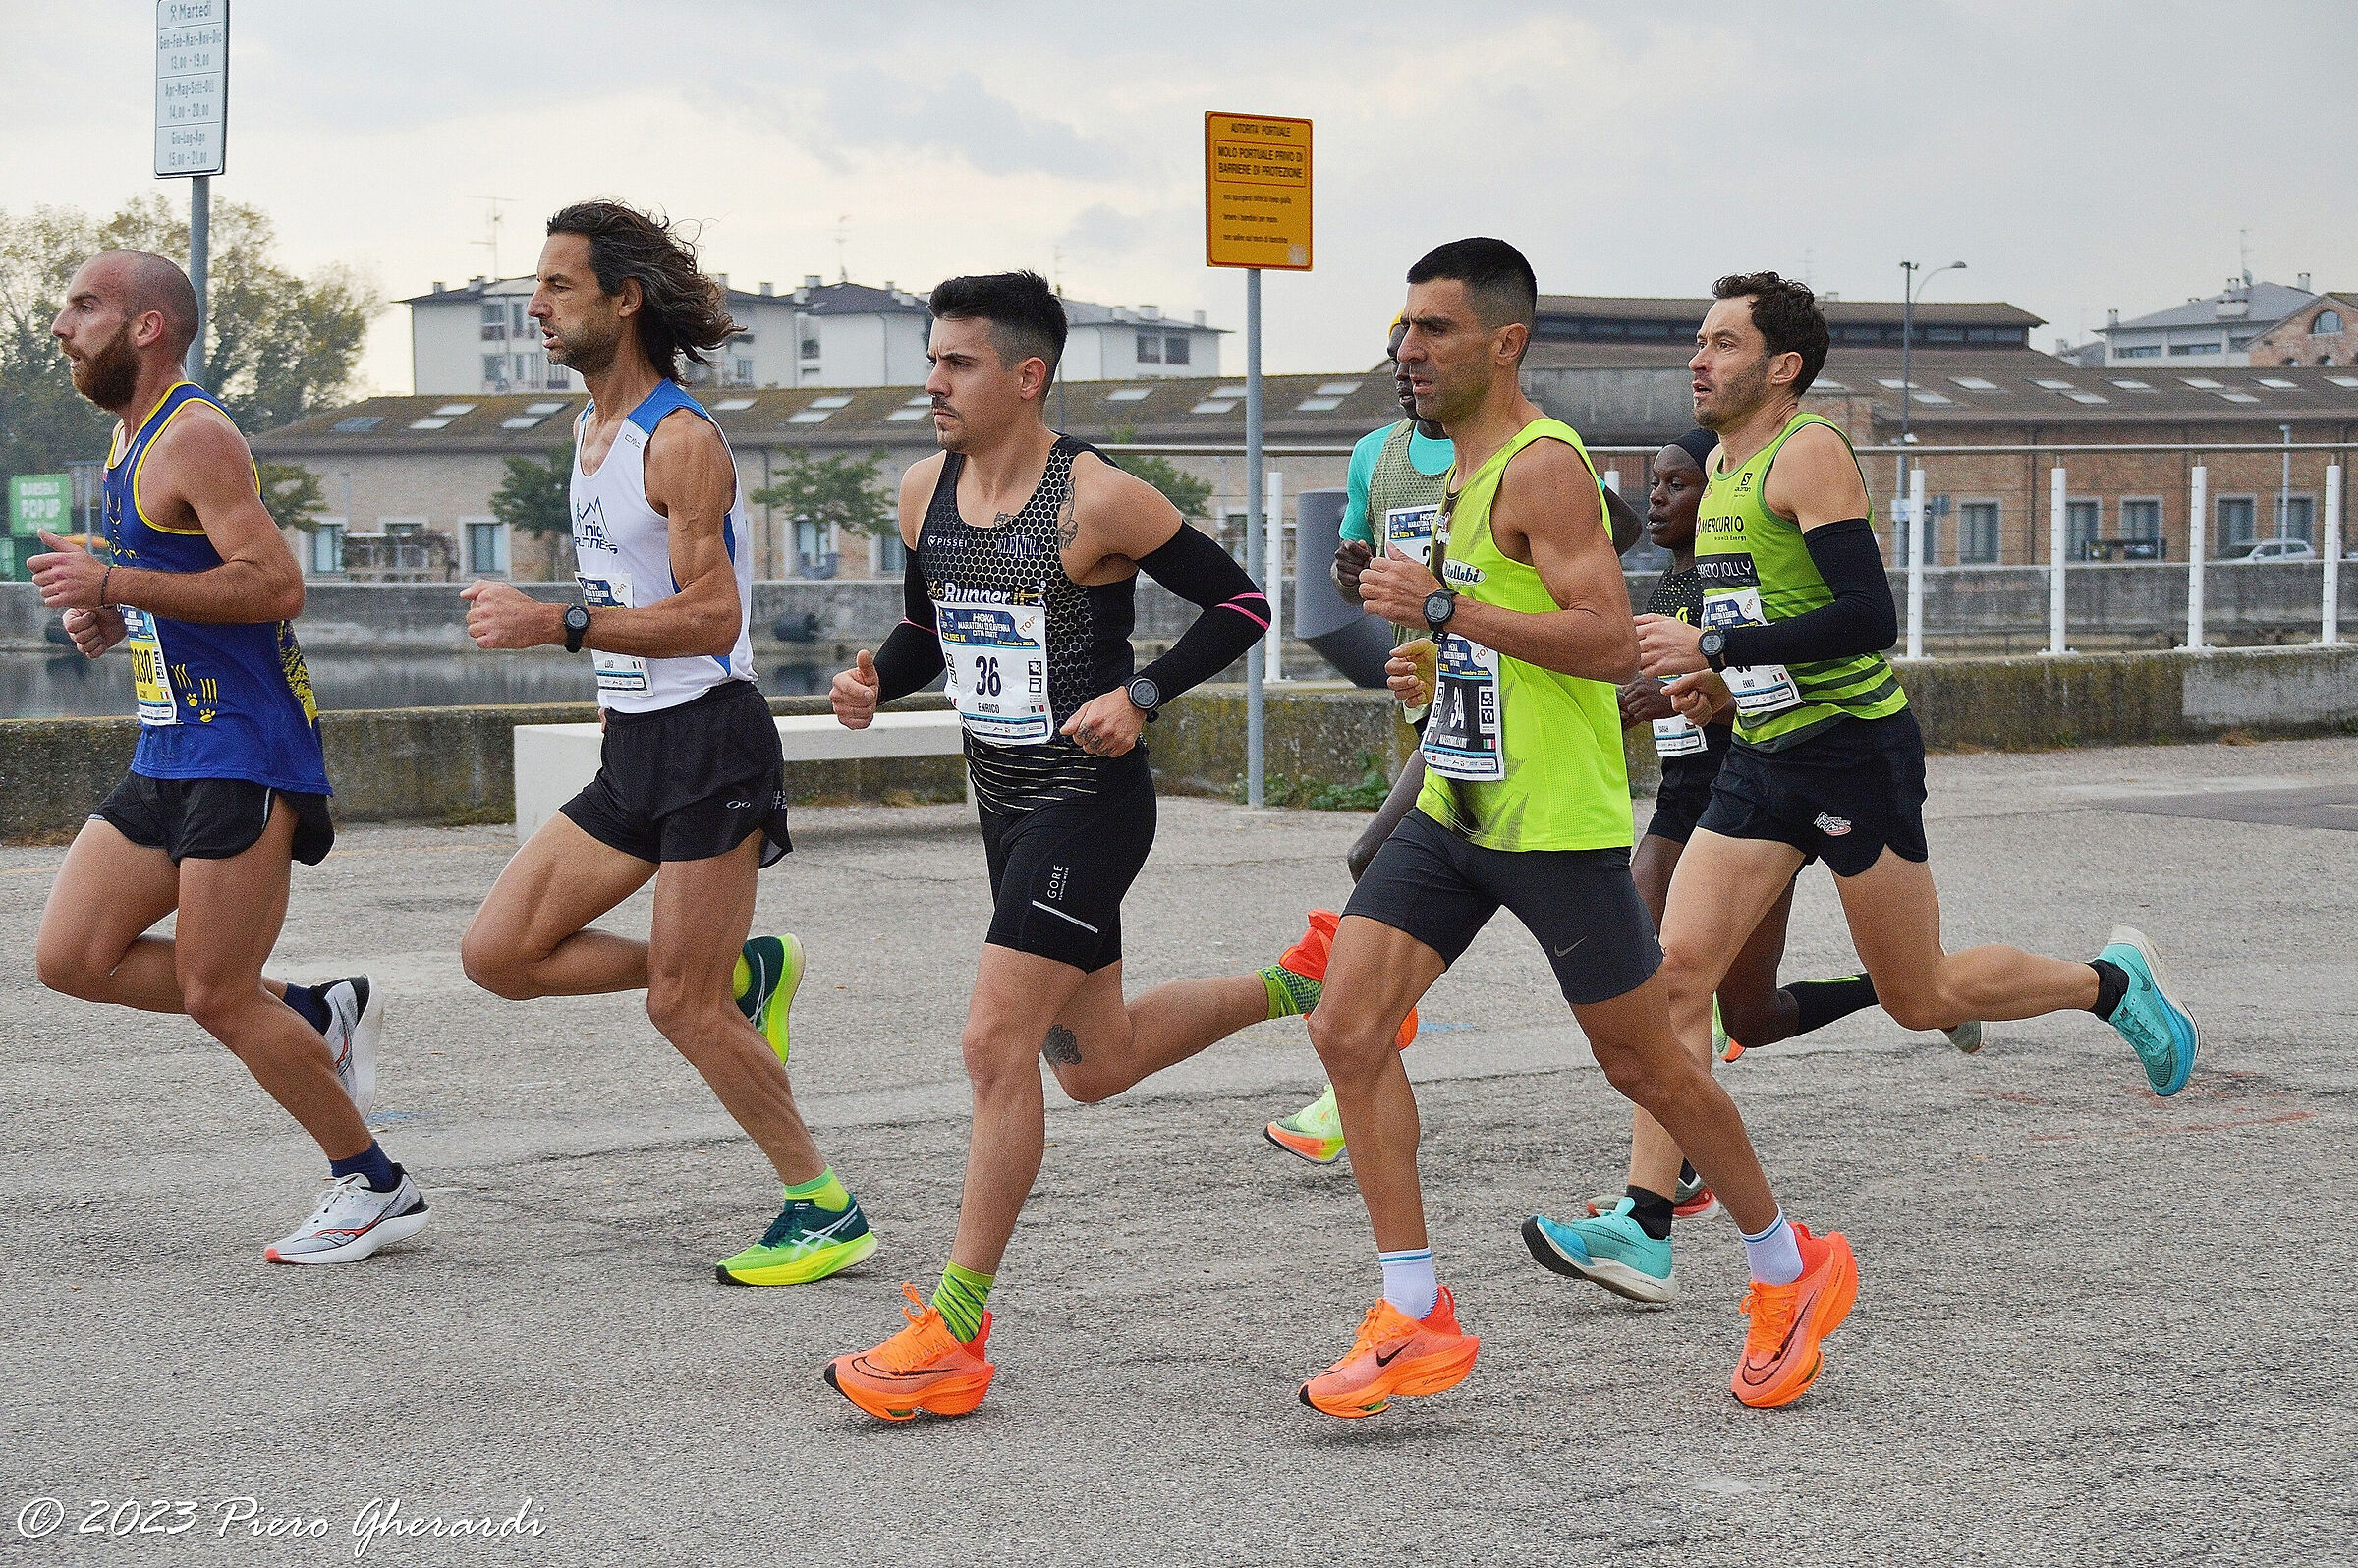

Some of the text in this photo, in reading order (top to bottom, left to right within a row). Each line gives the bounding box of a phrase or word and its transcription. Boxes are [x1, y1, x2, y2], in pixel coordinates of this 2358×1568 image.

[1240, 148, 1273, 160] PORTUALE
[1218, 162, 1251, 175] BARRIERE
[1262, 165, 1303, 178] PROTEZIONE
[1420, 512, 1436, 521] HOK
[1701, 515, 1744, 533] MERCURIO
[936, 537, 967, 547] PISSEI
[1719, 560, 1752, 578] JOLLY
[975, 655, 1002, 697] 36
[978, 702, 1000, 713] ENRICO
[1449, 686, 1465, 729] 34
[1047, 865, 1064, 899] GORE
